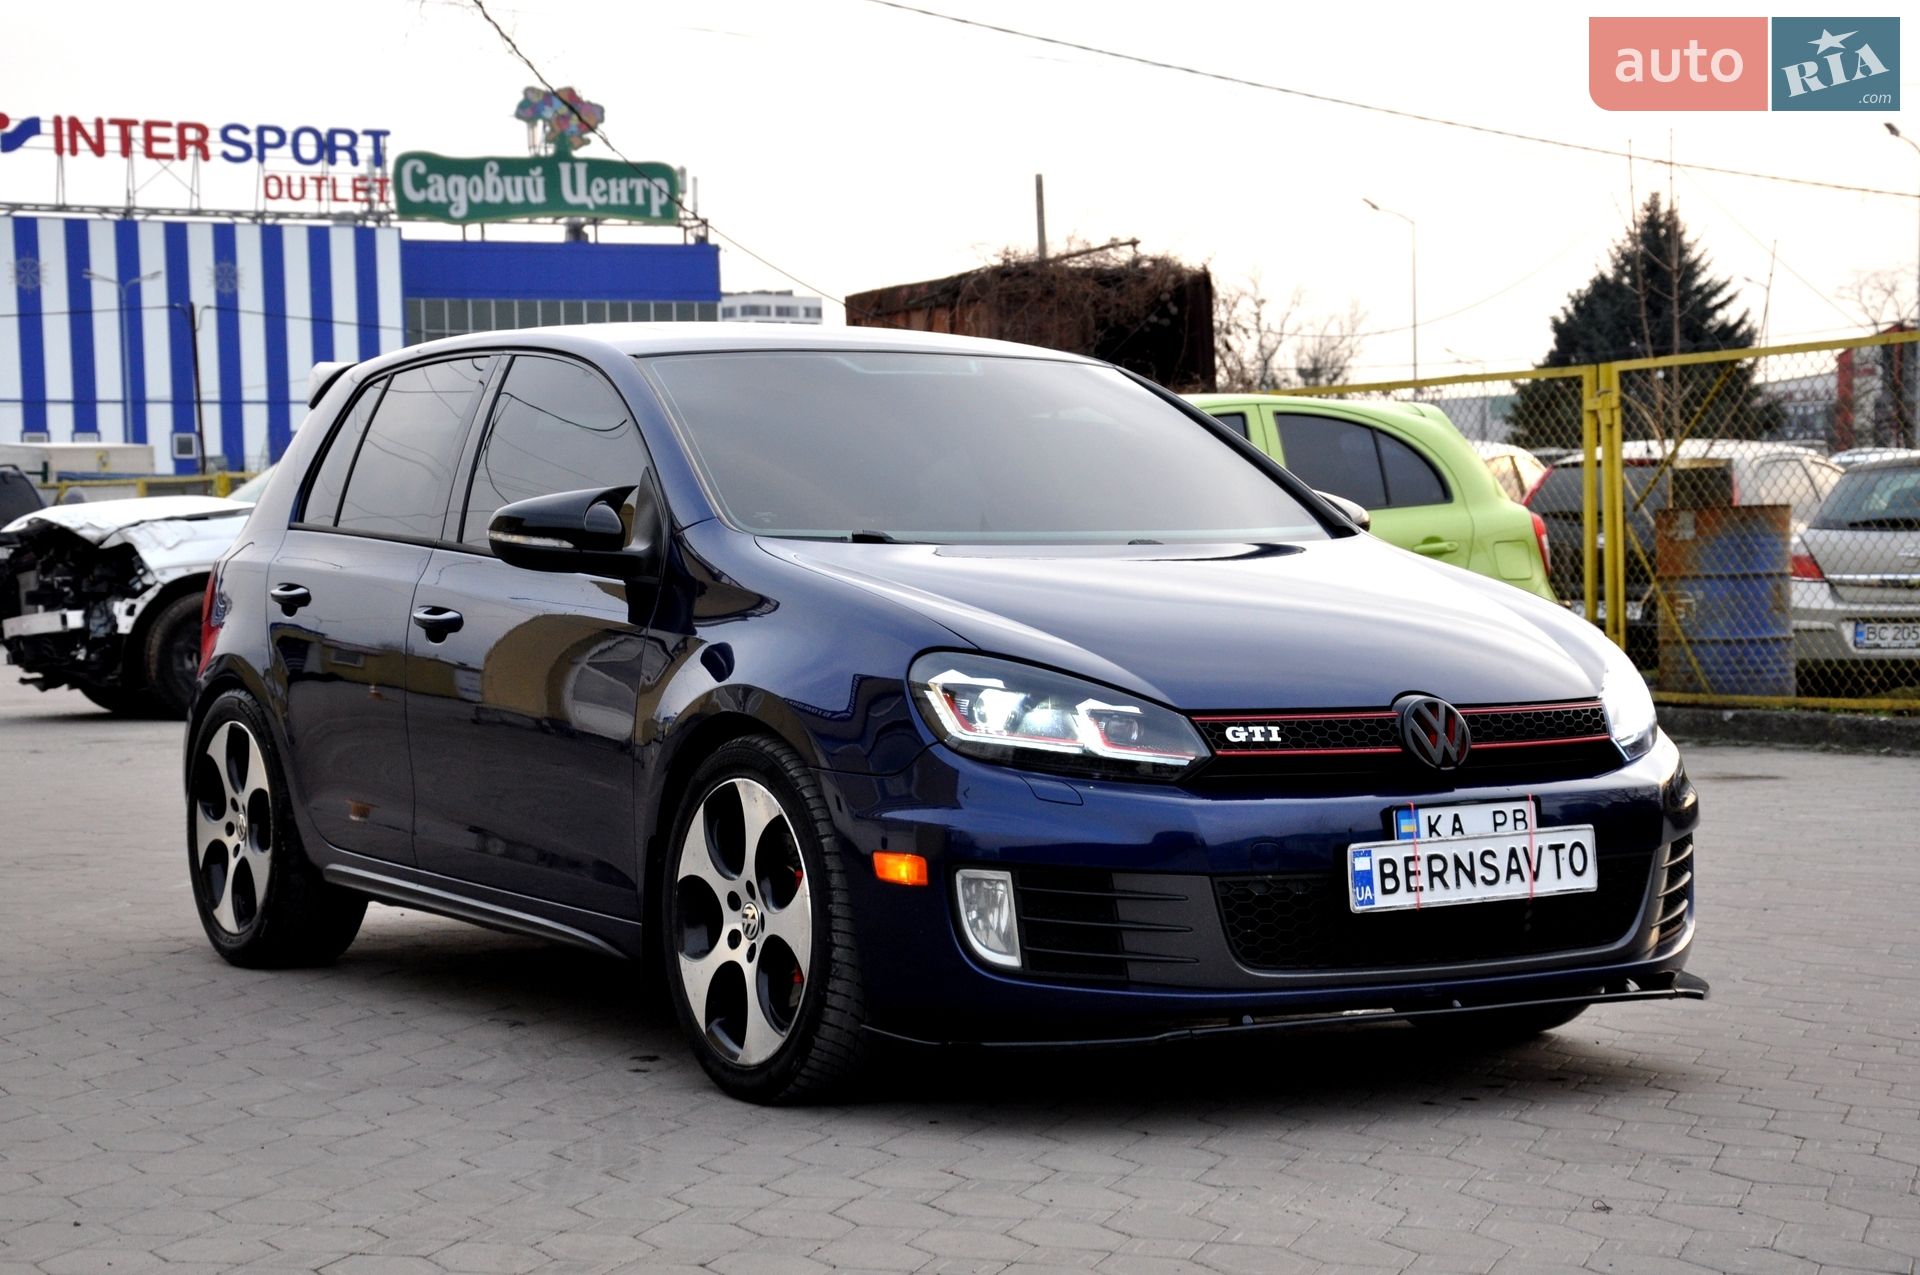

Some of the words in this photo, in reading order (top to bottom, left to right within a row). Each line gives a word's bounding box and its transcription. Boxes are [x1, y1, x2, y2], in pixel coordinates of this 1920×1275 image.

[264, 174, 390, 203] OUTLET
[401, 159, 547, 218] Садовий
[559, 161, 669, 217] Центр
[1225, 726, 1281, 742] GTI
[1427, 813, 1465, 838] KA
[1378, 841, 1588, 895] BERNSAVTO
[1356, 886, 1372, 900] UA
